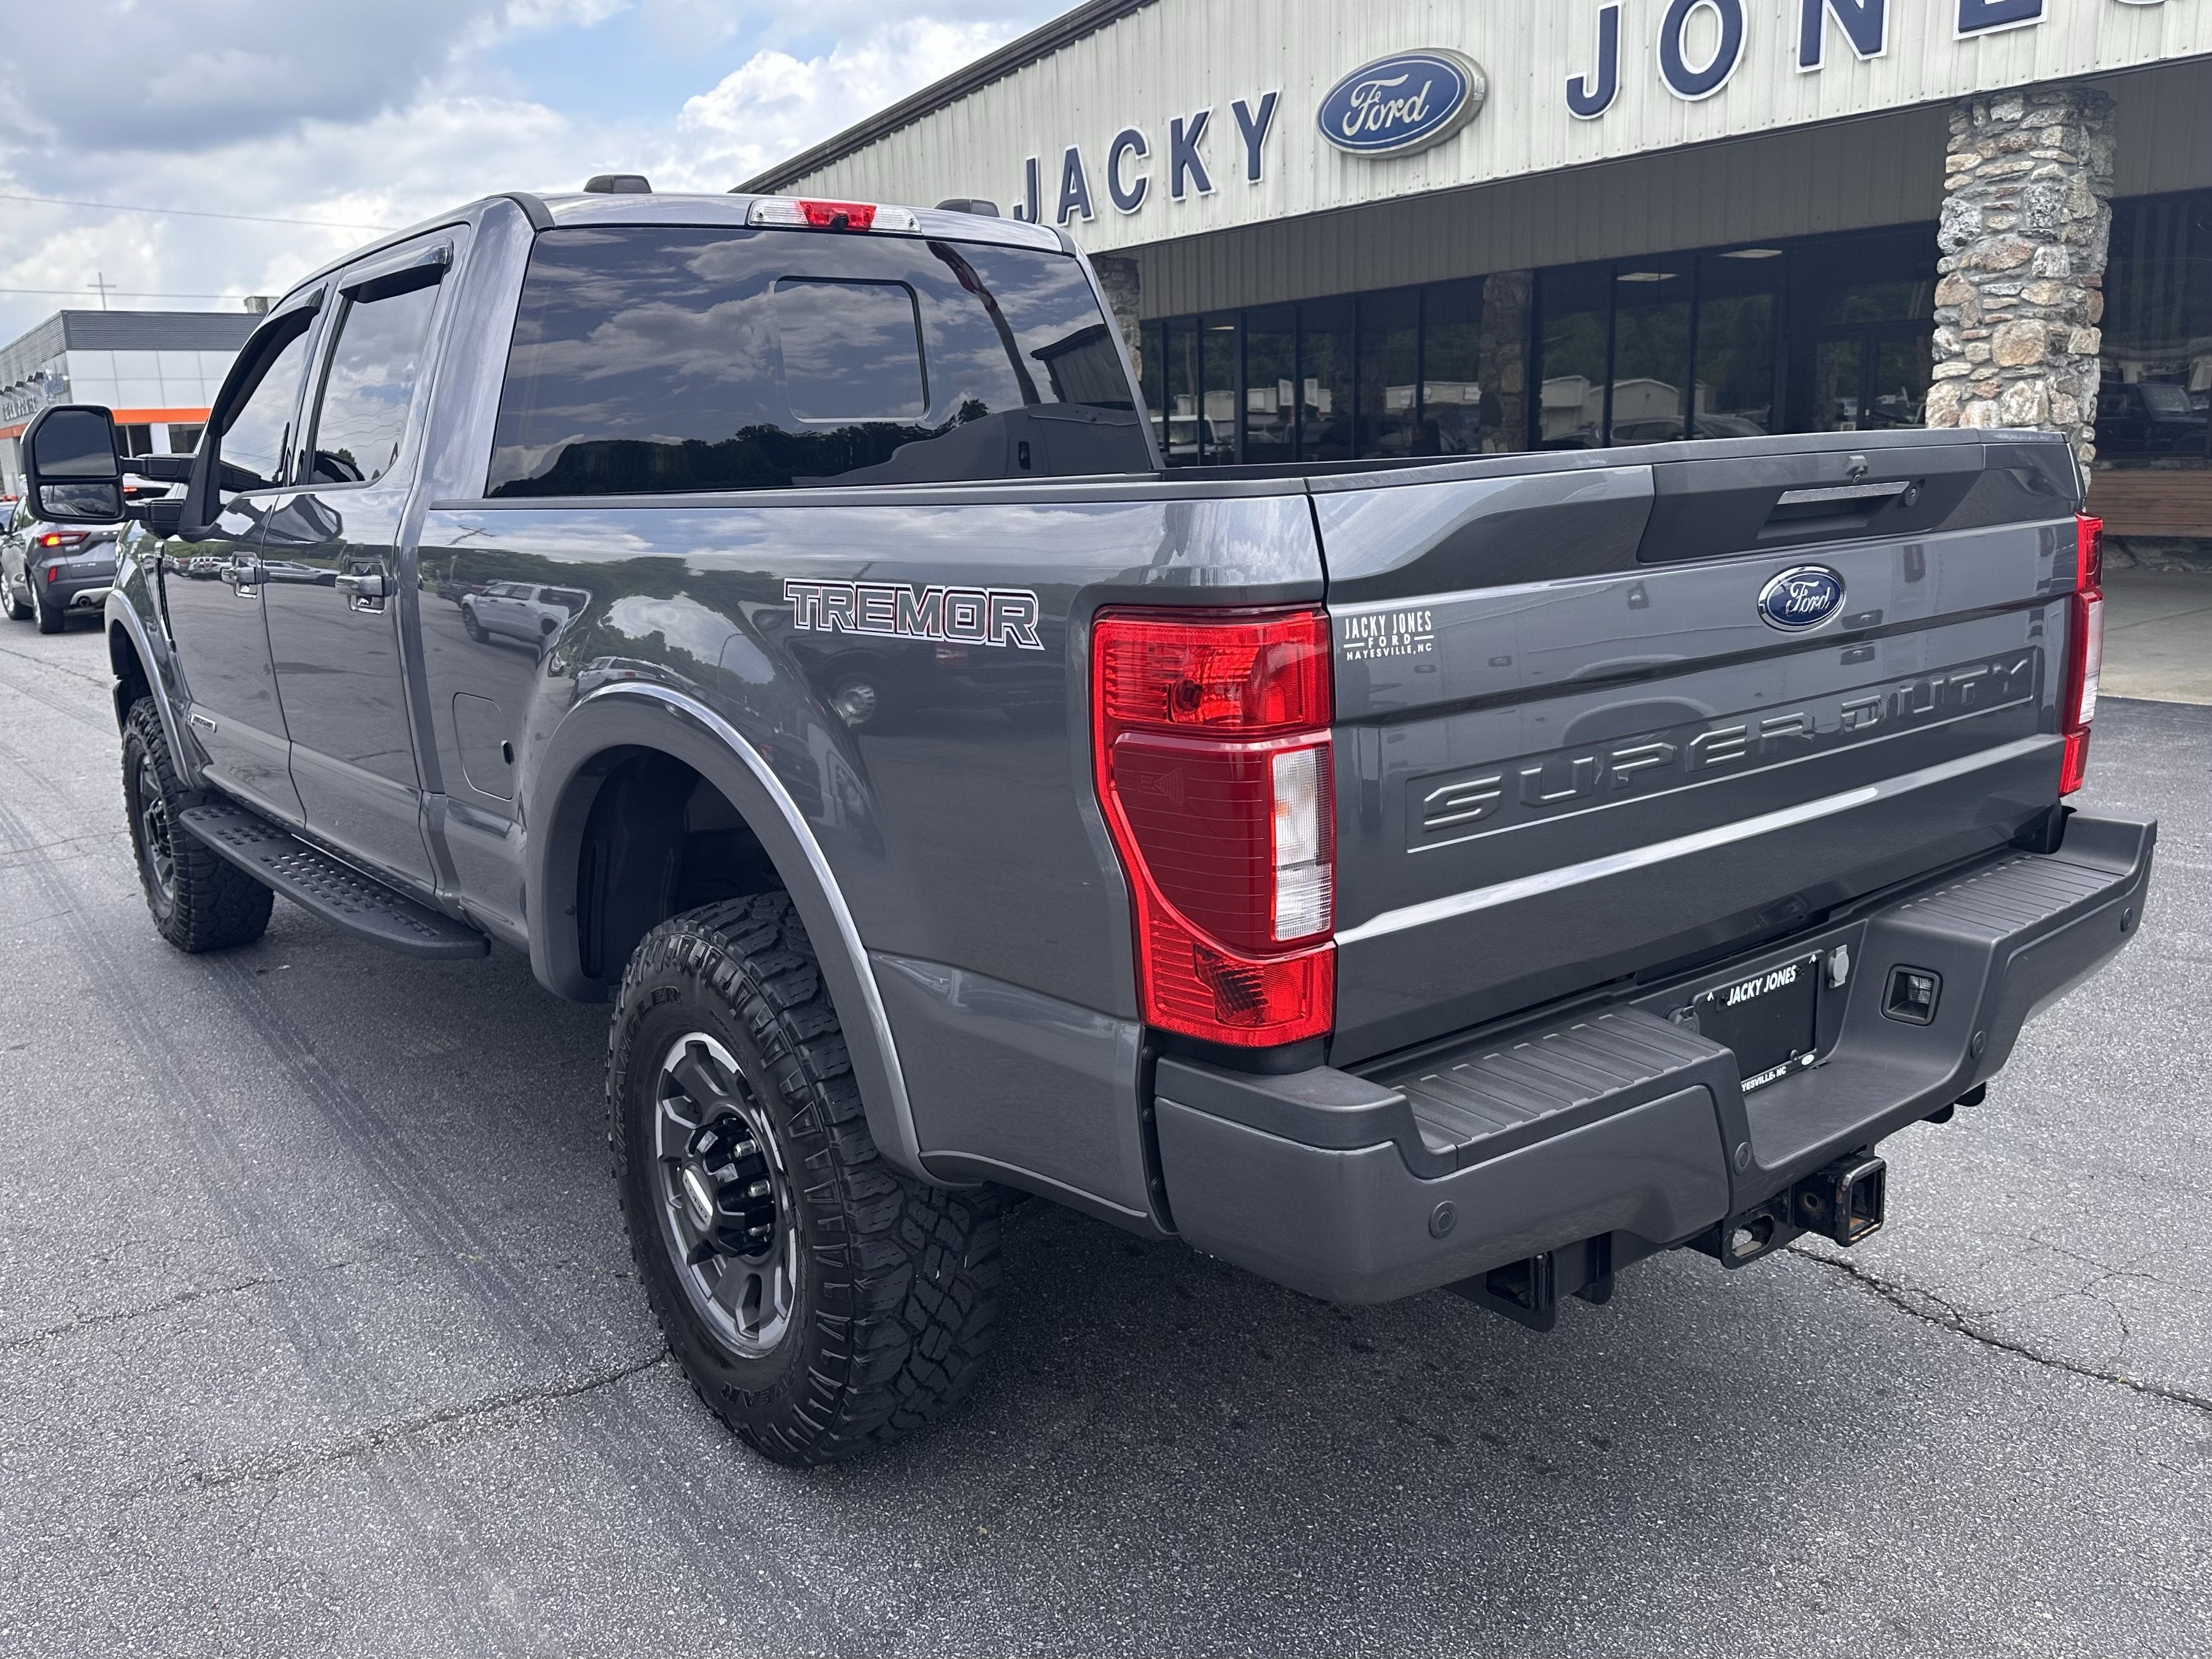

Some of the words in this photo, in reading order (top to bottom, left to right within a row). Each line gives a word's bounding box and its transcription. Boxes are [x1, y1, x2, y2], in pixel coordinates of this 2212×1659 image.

[1013, 88, 1281, 226] JACKY
[1565, 0, 2170, 120] JON
[1344, 74, 1433, 137] Ford
[784, 578, 1045, 651] TREMOR
[1786, 580, 1831, 616] Ford
[1345, 614, 1386, 640] JACKY
[1393, 610, 1432, 634] JONES
[1368, 633, 1411, 649] FORD
[1422, 710, 1817, 833] SUPER
[1840, 656, 2029, 732] DUTY
[1726, 978, 1763, 1007] JACKY
[1763, 964, 1797, 993] JONES
[1741, 1070, 1776, 1092] YESVILLE,
[1776, 1065, 1787, 1078] NC
